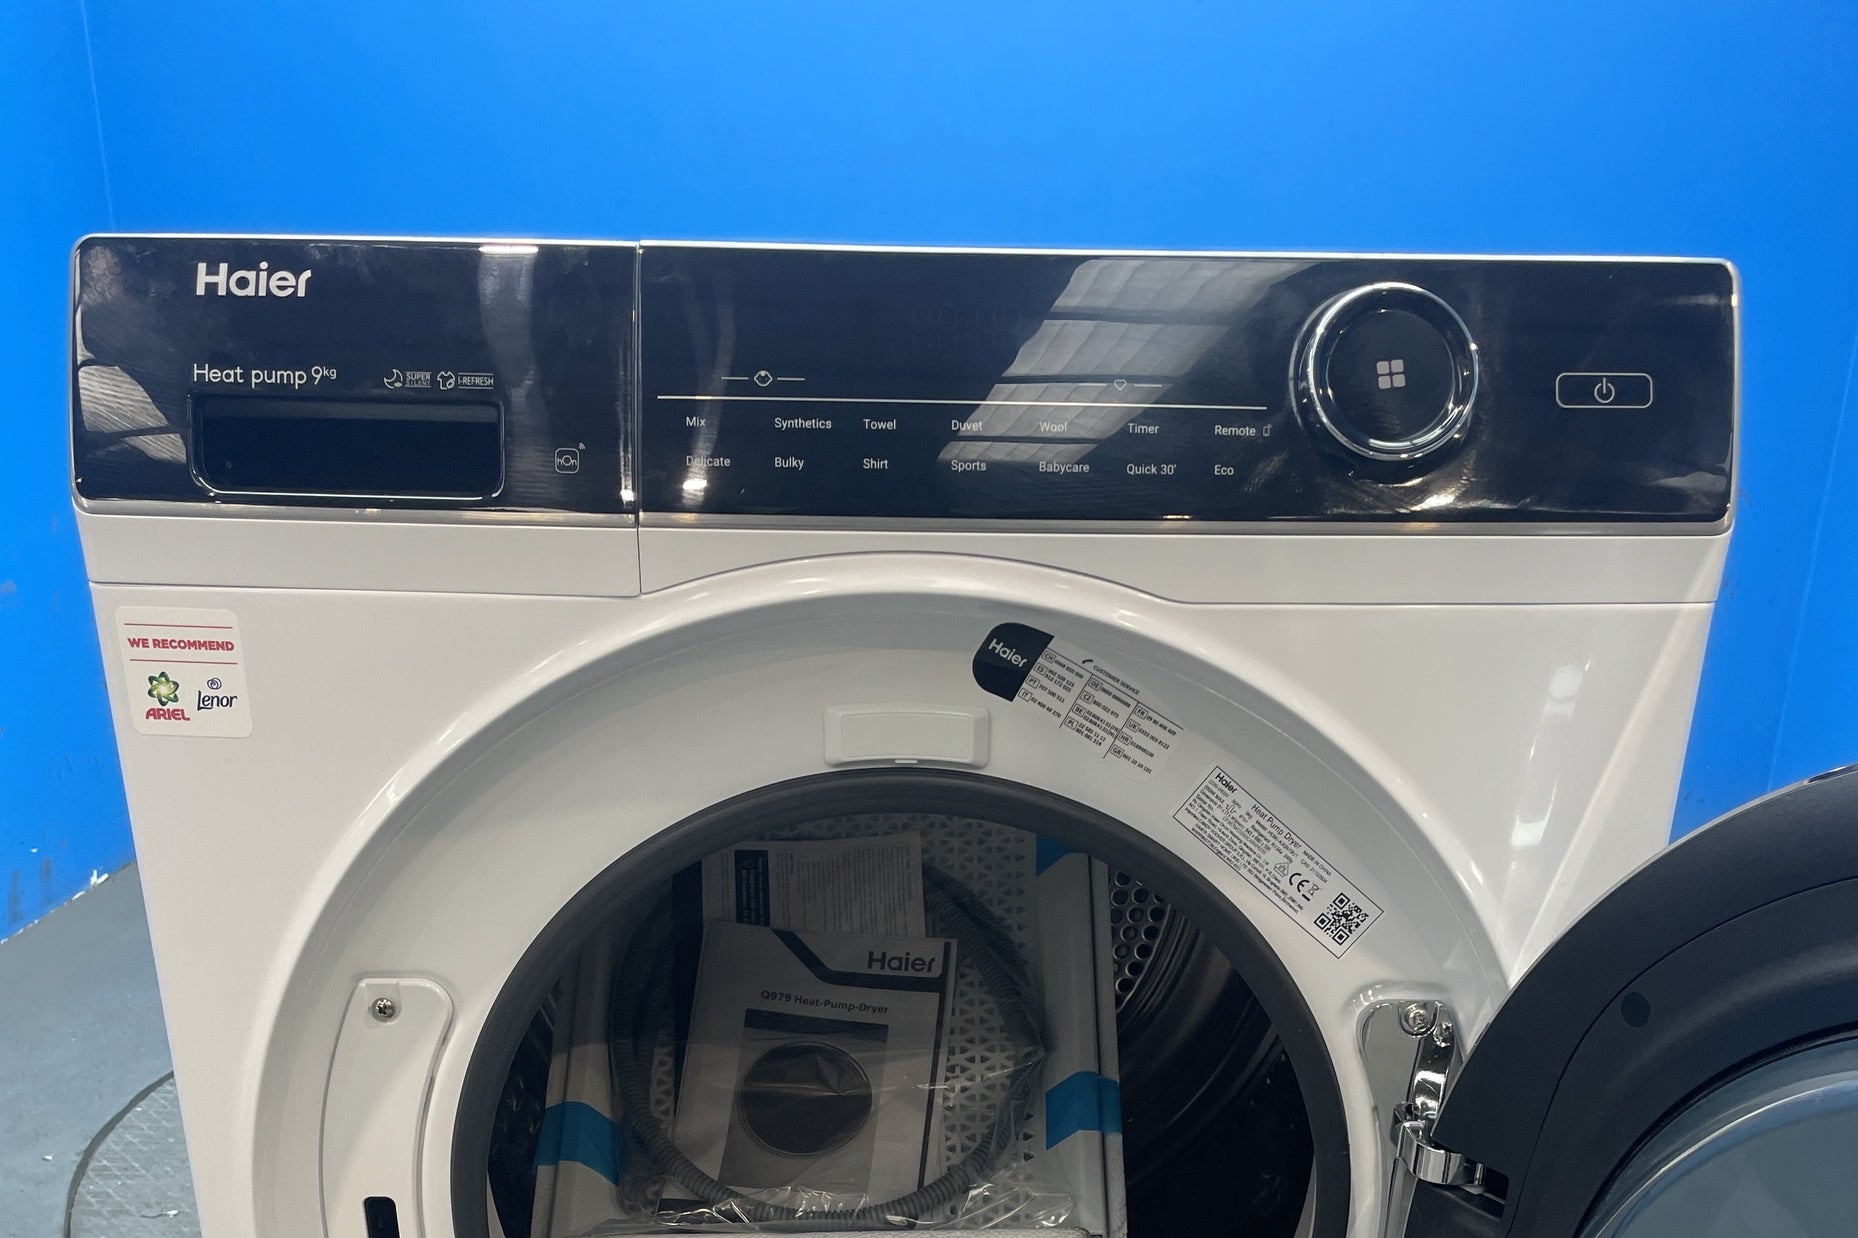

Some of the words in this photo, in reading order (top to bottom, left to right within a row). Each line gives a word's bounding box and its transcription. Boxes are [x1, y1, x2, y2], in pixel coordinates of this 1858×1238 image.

[195, 261, 312, 297] Haier
[193, 363, 243, 384] Heat
[251, 368, 307, 388] pump
[312, 366, 337, 386] 9kg
[406, 373, 431, 381] SUPER
[458, 376, 494, 386] I-REFRESH
[686, 417, 706, 428] Mix
[774, 417, 832, 431] Synthetics
[863, 418, 897, 431] Towel
[951, 419, 983, 432] Duvet
[1039, 420, 1068, 433] Wool
[1128, 423, 1160, 435] Timer
[1214, 425, 1257, 437] Remote
[686, 455, 731, 468] Delicate
[774, 457, 804, 470] Bulky
[863, 458, 889, 470] Shirt
[951, 459, 987, 473] Sports
[1039, 461, 1090, 475] Babycare
[1127, 463, 1157, 476] Quick
[1214, 464, 1234, 476] Eco
[127, 637, 149, 648] WE
[152, 638, 234, 651] RECOMMEND
[988, 638, 1028, 668] Haier
[1028, 678, 1037, 686] PT
[1092, 664, 1120, 683] CUSTOMER
[1119, 680, 1140, 695] SERVICE
[197, 690, 238, 711] Lenor
[145, 707, 191, 721] ARIEL
[1128, 721, 1137, 730] UK
[1120, 734, 1129, 742] HR
[1112, 747, 1121, 755] GR
[1215, 772, 1239, 794] Haier
[1251, 803, 1268, 820] Heat
[1265, 816, 1286, 836] Pump
[1282, 832, 1303, 851] Dryer
[867, 951, 936, 973] Haier
[760, 989, 792, 1003] Q979
[793, 995, 888, 1015] Heat-Pump-Dryer
